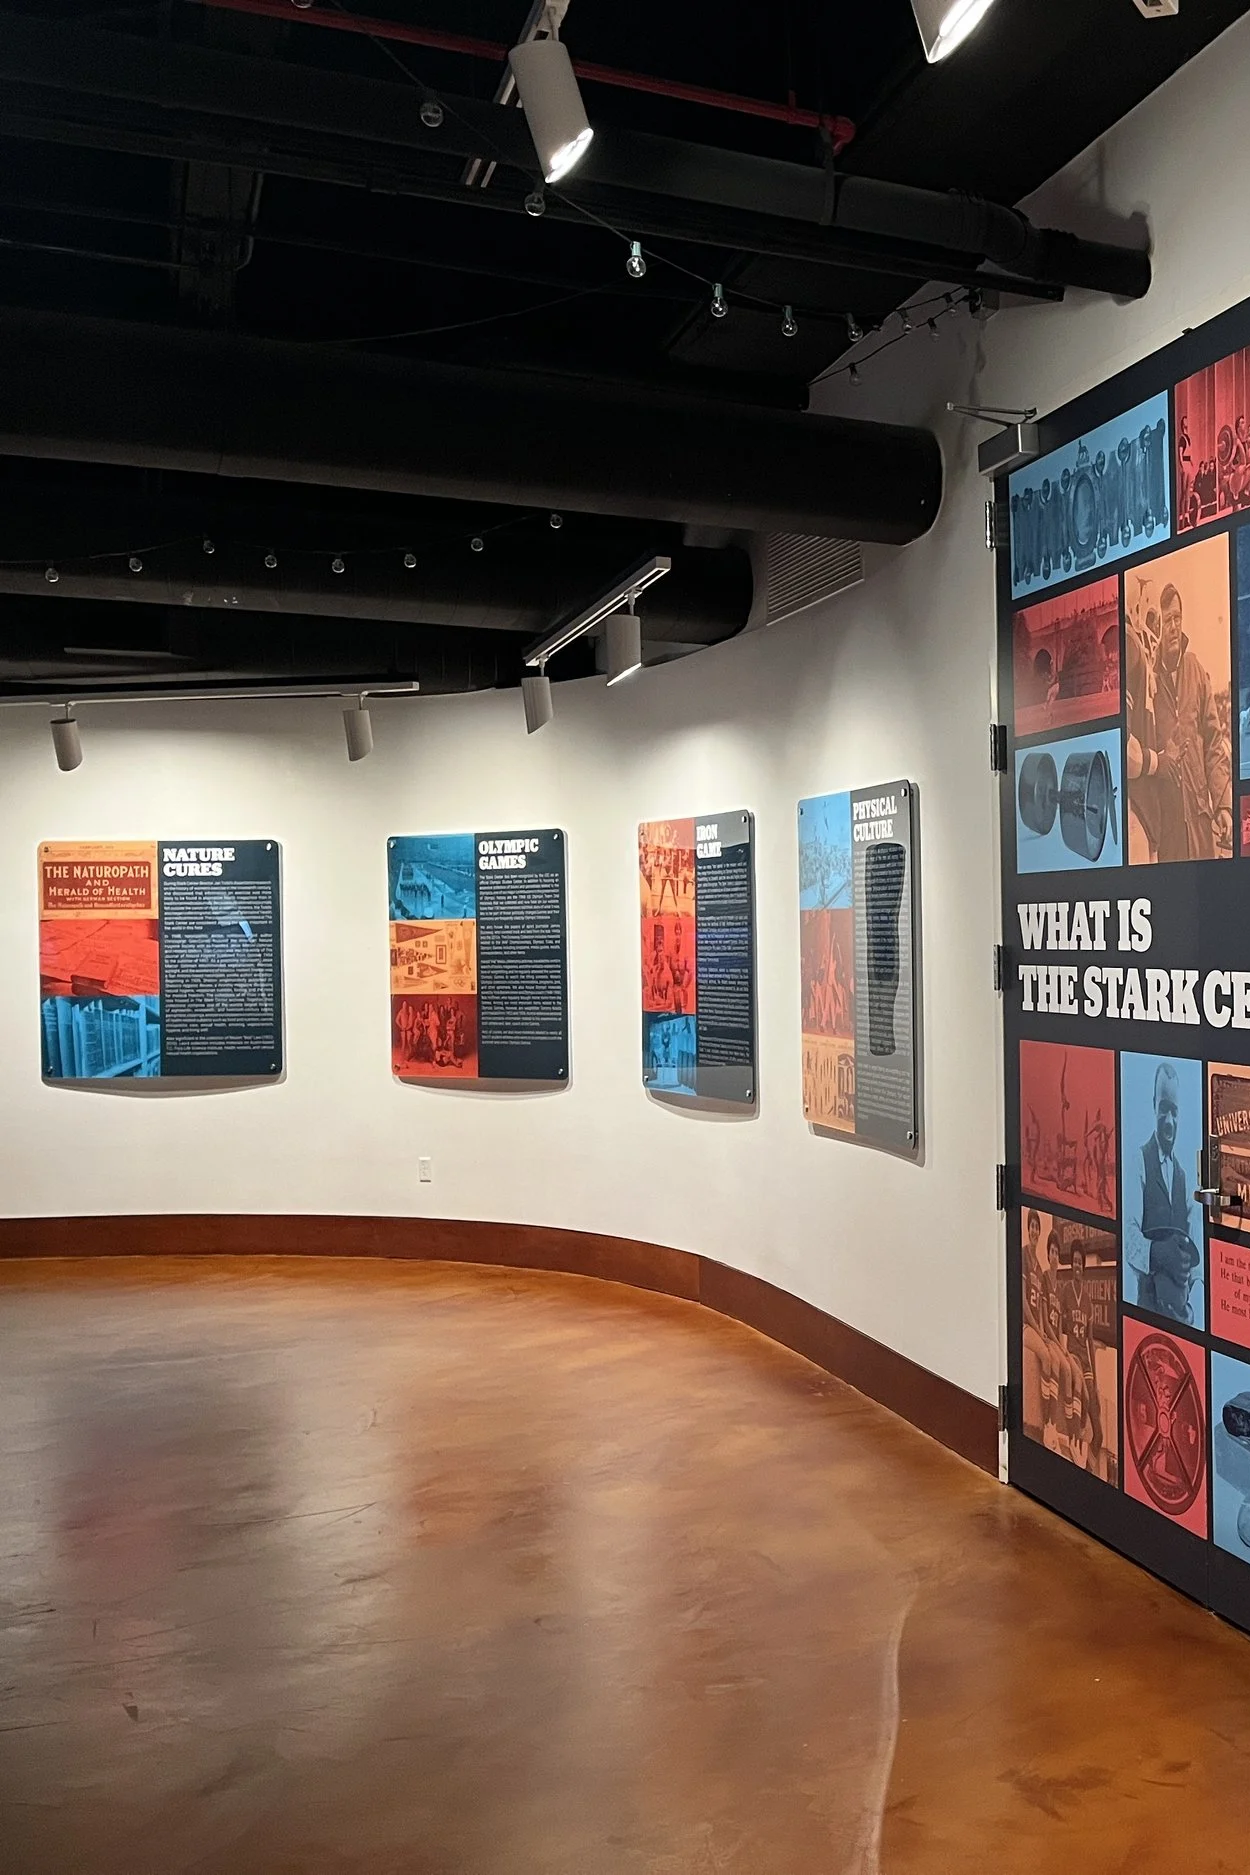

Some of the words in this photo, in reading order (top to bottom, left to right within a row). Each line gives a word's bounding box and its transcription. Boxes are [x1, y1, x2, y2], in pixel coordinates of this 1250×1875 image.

[852, 796, 898, 822] PHYSICAL
[696, 823, 718, 842] IRON
[853, 818, 894, 842] CULTURE
[163, 847, 235, 862] NATURE
[478, 838, 539, 856] OLYMPIC
[696, 841, 722, 859] GAME
[163, 862, 223, 877] CURES
[478, 854, 527, 870] GAMES
[45, 865, 69, 879] THE
[73, 865, 149, 879] NATUROPATH
[49, 886, 90, 896] HERALD
[92, 887, 105, 896] OF
[108, 886, 146, 896] HEALTH
[86, 879, 110, 887] AND
[1017, 900, 1110, 952] WHAT
[1117, 898, 1152, 953] IS
[1018, 964, 1079, 1015] THE
[1083, 965, 1201, 1026] STARK
[1219, 1251, 1224, 1263] I
[1224, 1256, 1234, 1265] am
[1236, 1259, 1246, 1269] the
[1220, 1267, 1230, 1280] He
[1231, 1271, 1243, 1284] that
[1233, 1289, 1242, 1300] of
[1220, 1298, 1230, 1312] He
[1231, 1305, 1246, 1317] most
